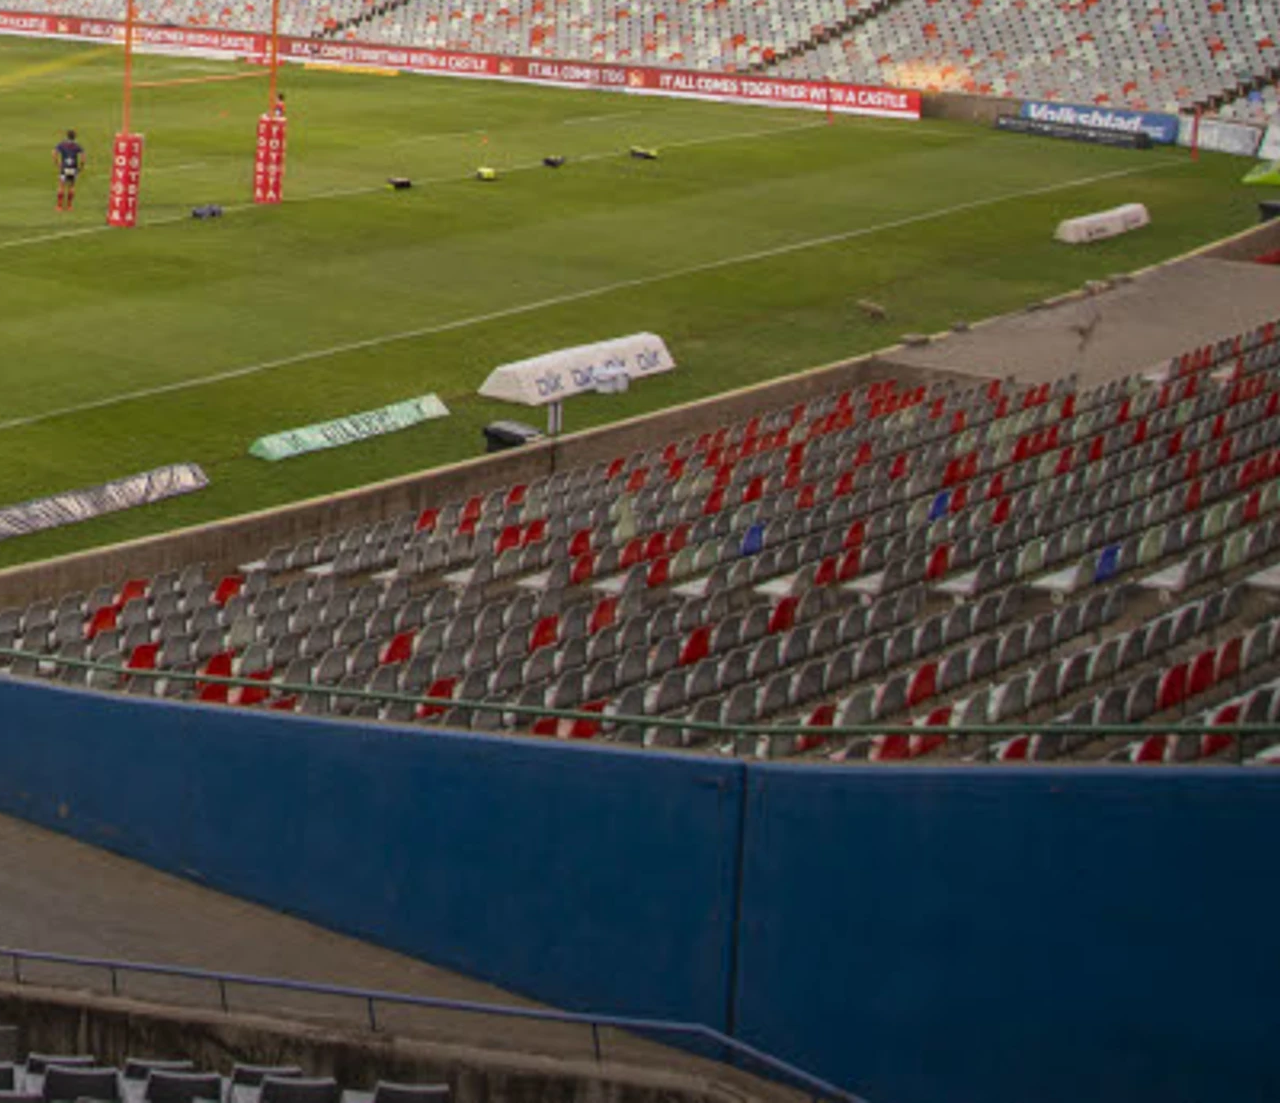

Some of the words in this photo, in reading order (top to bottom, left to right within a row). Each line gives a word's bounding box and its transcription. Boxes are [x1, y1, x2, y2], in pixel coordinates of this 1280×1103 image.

[659, 75, 672, 87] IT
[673, 75, 695, 89] ALL
[696, 77, 738, 93] COMES
[741, 82, 807, 99] TOGETHER
[845, 91, 856, 103] A
[858, 93, 908, 109] CASTLE
[110, 142, 127, 222] TOYOTA
[266, 125, 281, 200] TOYOTA
